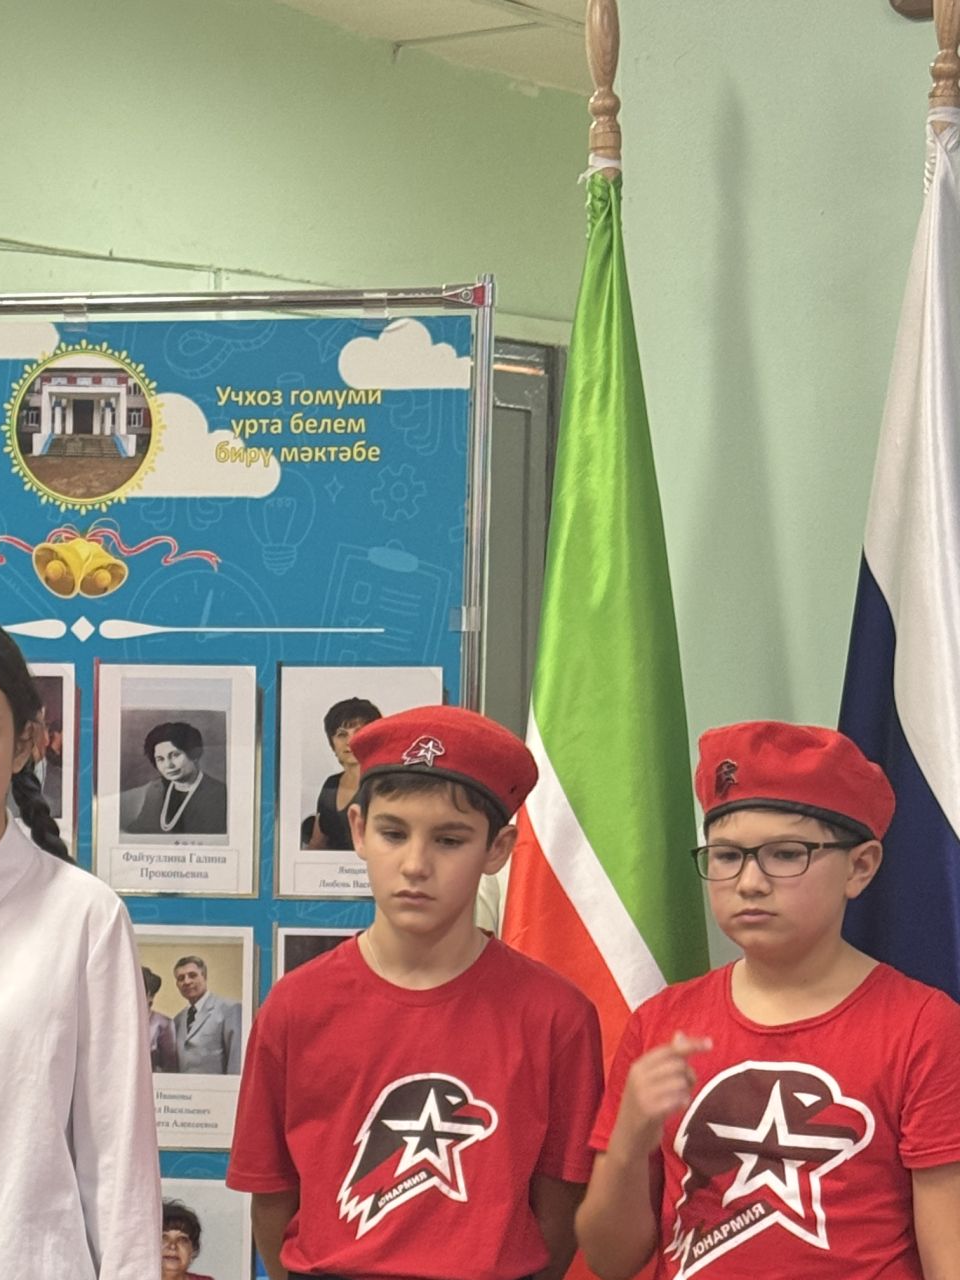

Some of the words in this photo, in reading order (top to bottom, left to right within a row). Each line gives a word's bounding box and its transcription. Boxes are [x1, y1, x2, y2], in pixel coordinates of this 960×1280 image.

[215, 385, 283, 407] Учхоз
[290, 389, 382, 410] гомуми
[230, 417, 283, 439] урта
[290, 412, 366, 435] белем
[215, 440, 273, 467] бирү
[280, 440, 382, 463] мәктәбе
[189, 853, 227, 864] Галина
[140, 867, 209, 880] Прокопьевна
[378, 1170, 429, 1208] ЮНАРМИЯ
[692, 1202, 766, 1259] ЮНАРМИЯ
